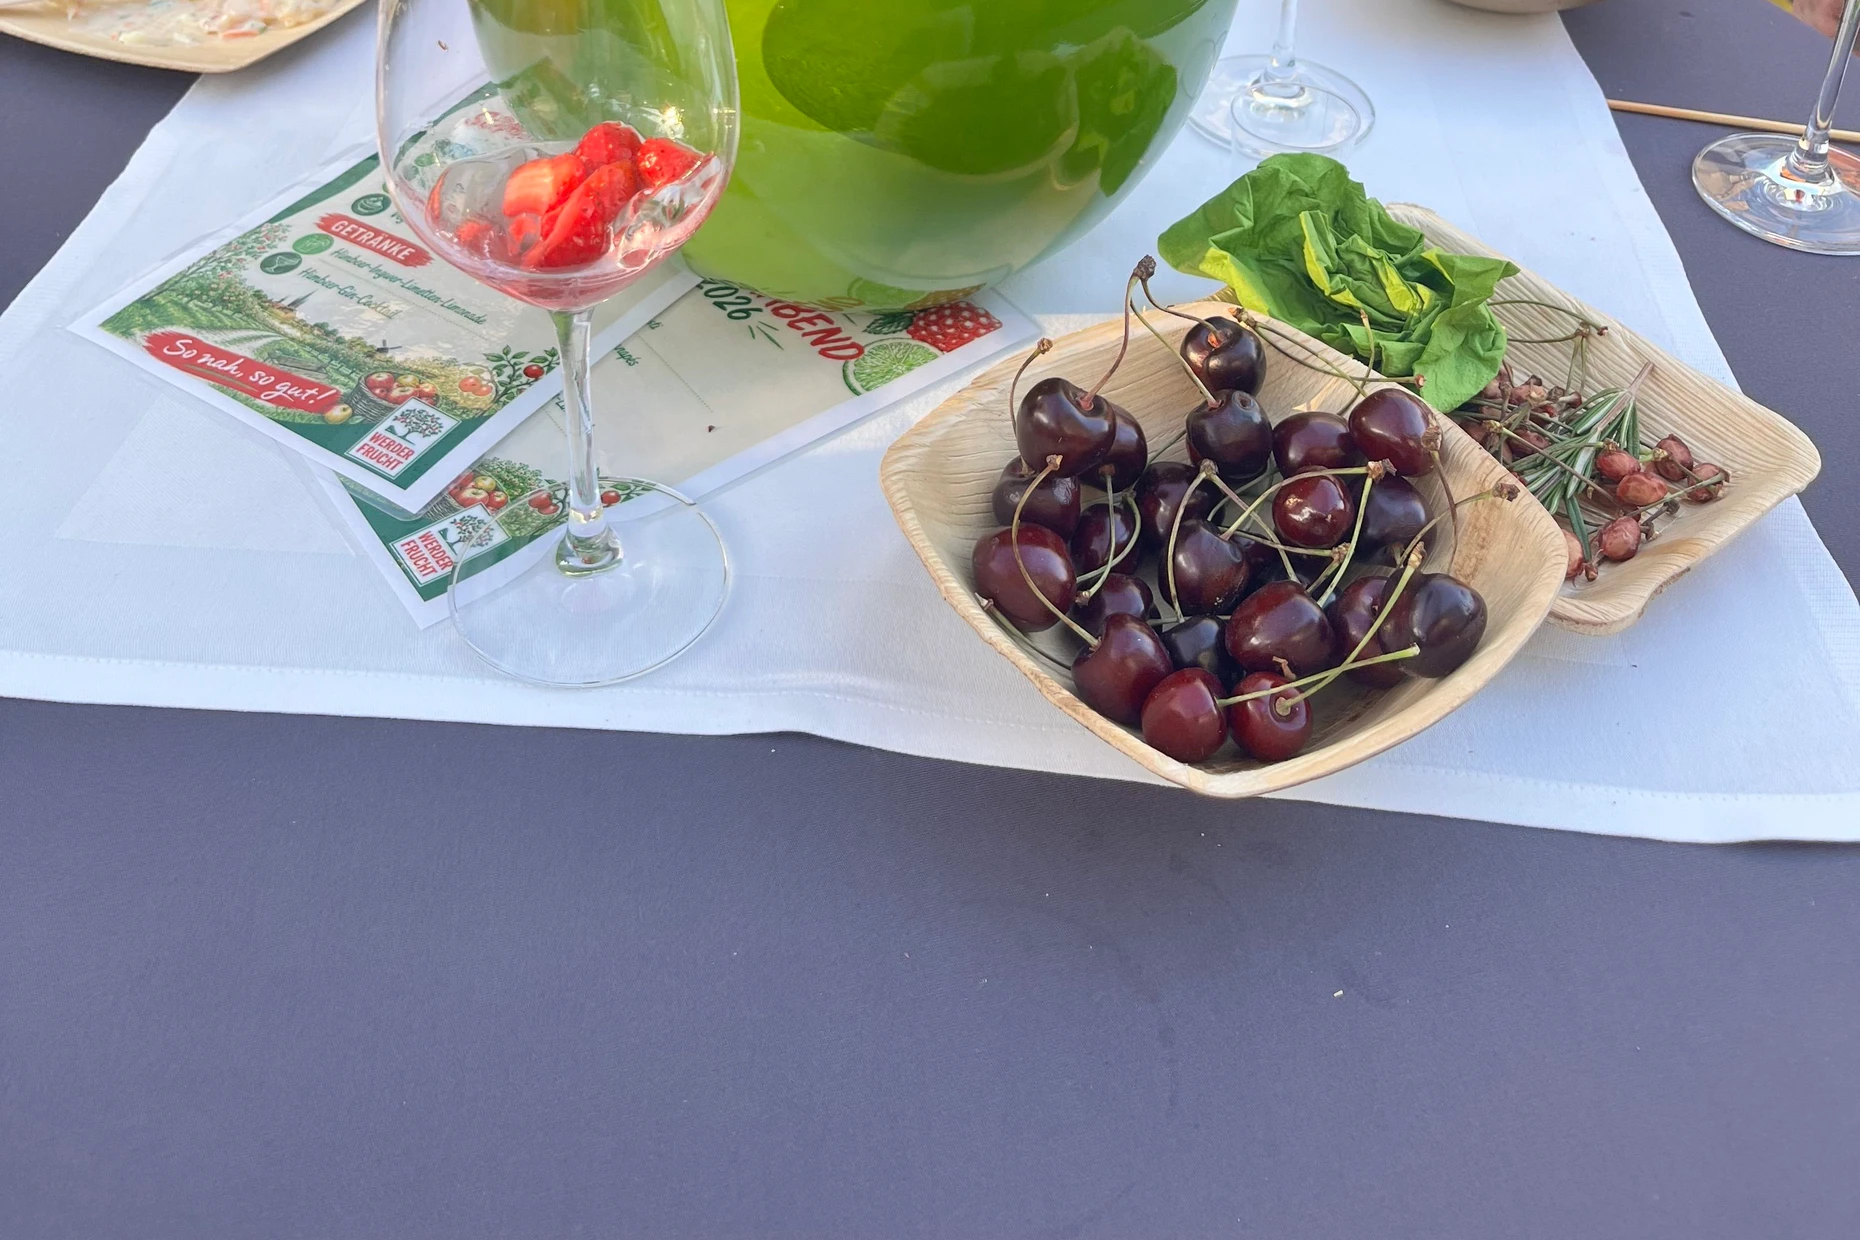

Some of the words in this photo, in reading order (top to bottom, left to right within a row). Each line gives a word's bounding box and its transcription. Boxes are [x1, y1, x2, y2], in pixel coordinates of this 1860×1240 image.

[330, 220, 417, 260] GETRÄNKE
[298, 267, 404, 321] Himbeer-Gin-Cocktail
[330, 248, 488, 325] Himbeer-Ingwer-Limetten-Limonade
[763, 298, 865, 361] BEND
[162, 338, 198, 359] So
[197, 355, 245, 378] nah,
[249, 370, 276, 387] so
[259, 380, 338, 405] gut!
[355, 442, 405, 472] FRUCHT
[368, 431, 416, 461] WERDER
[400, 539, 439, 578] FRUCHT
[418, 530, 455, 571] WERDER
